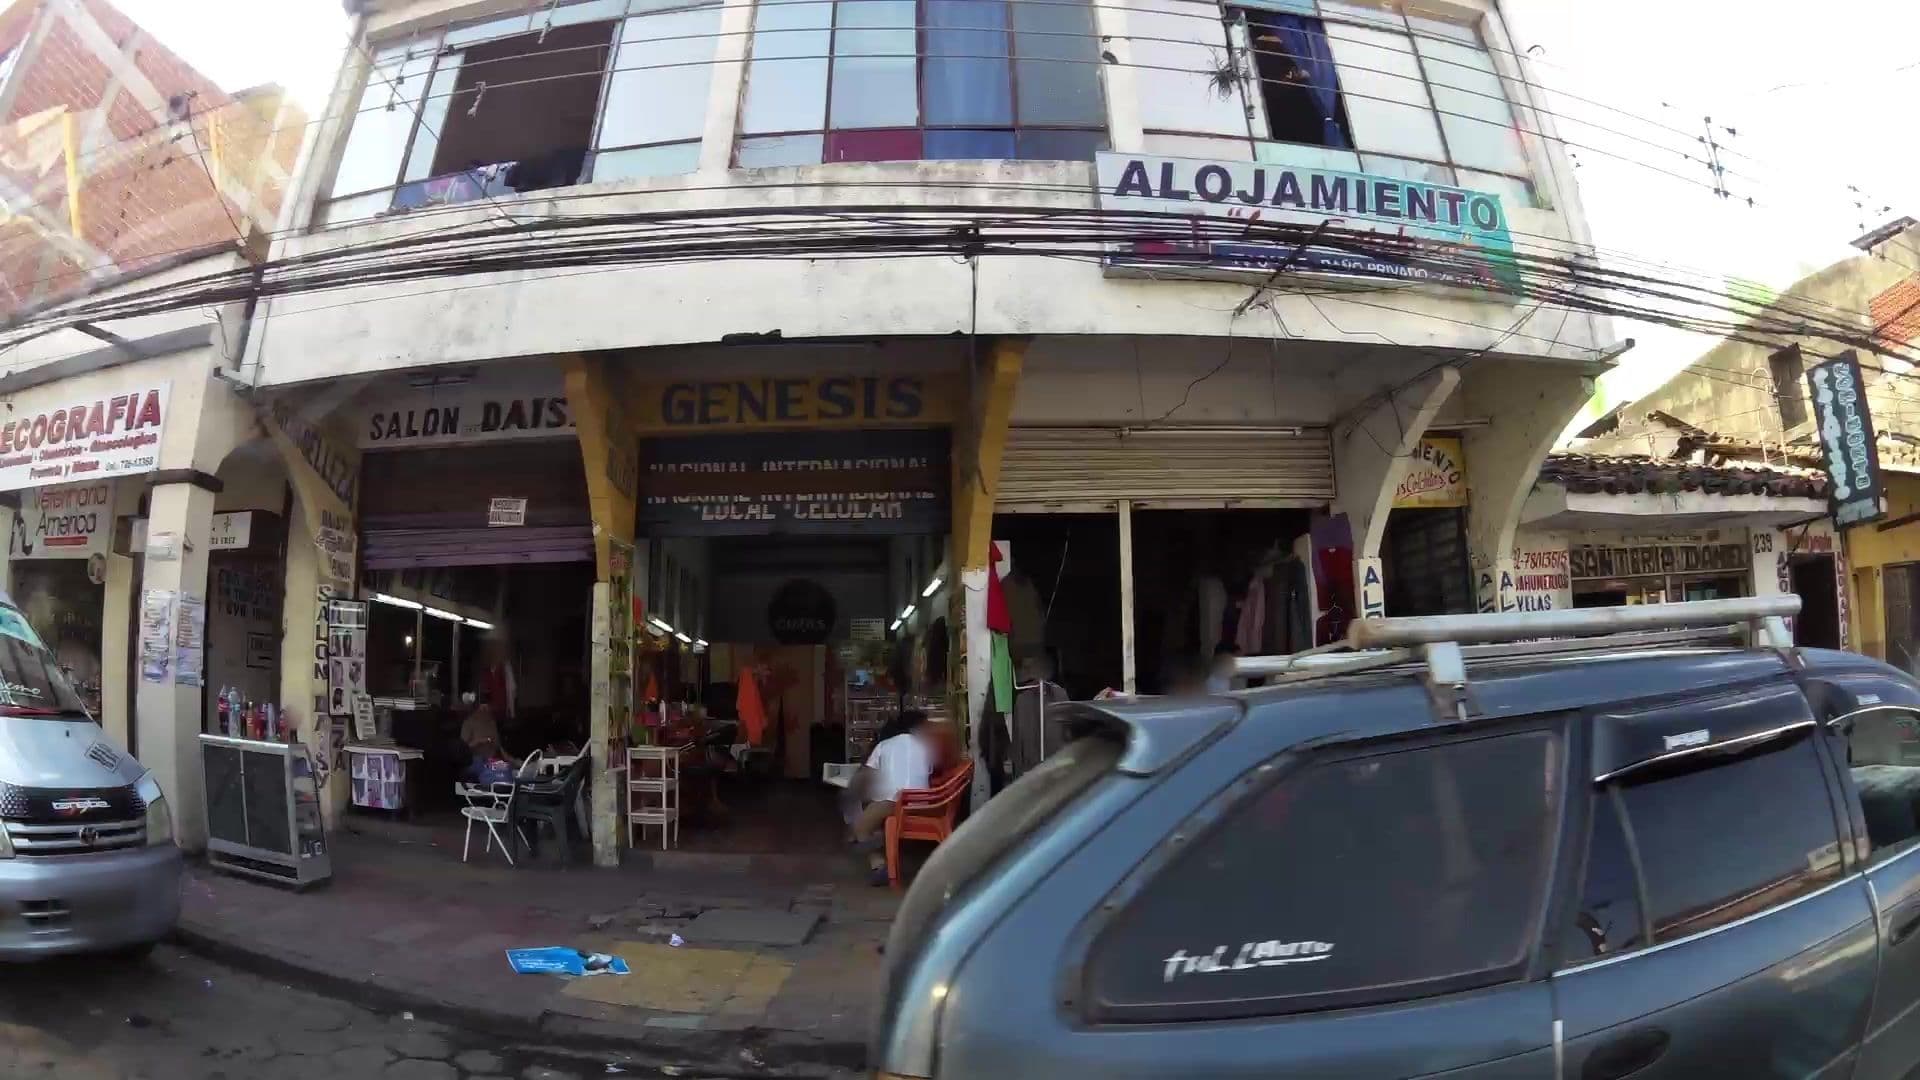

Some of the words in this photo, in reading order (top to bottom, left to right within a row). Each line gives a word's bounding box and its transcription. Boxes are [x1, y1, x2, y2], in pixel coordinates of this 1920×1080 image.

[1115, 159, 1498, 231] ALOJAMIENTO
[0, 389, 161, 454] ECOGRAFIA
[370, 406, 459, 440] SALON
[481, 397, 577, 432] DAIS
[661, 376, 924, 426] GENESIS
[1753, 532, 1773, 554] 239
